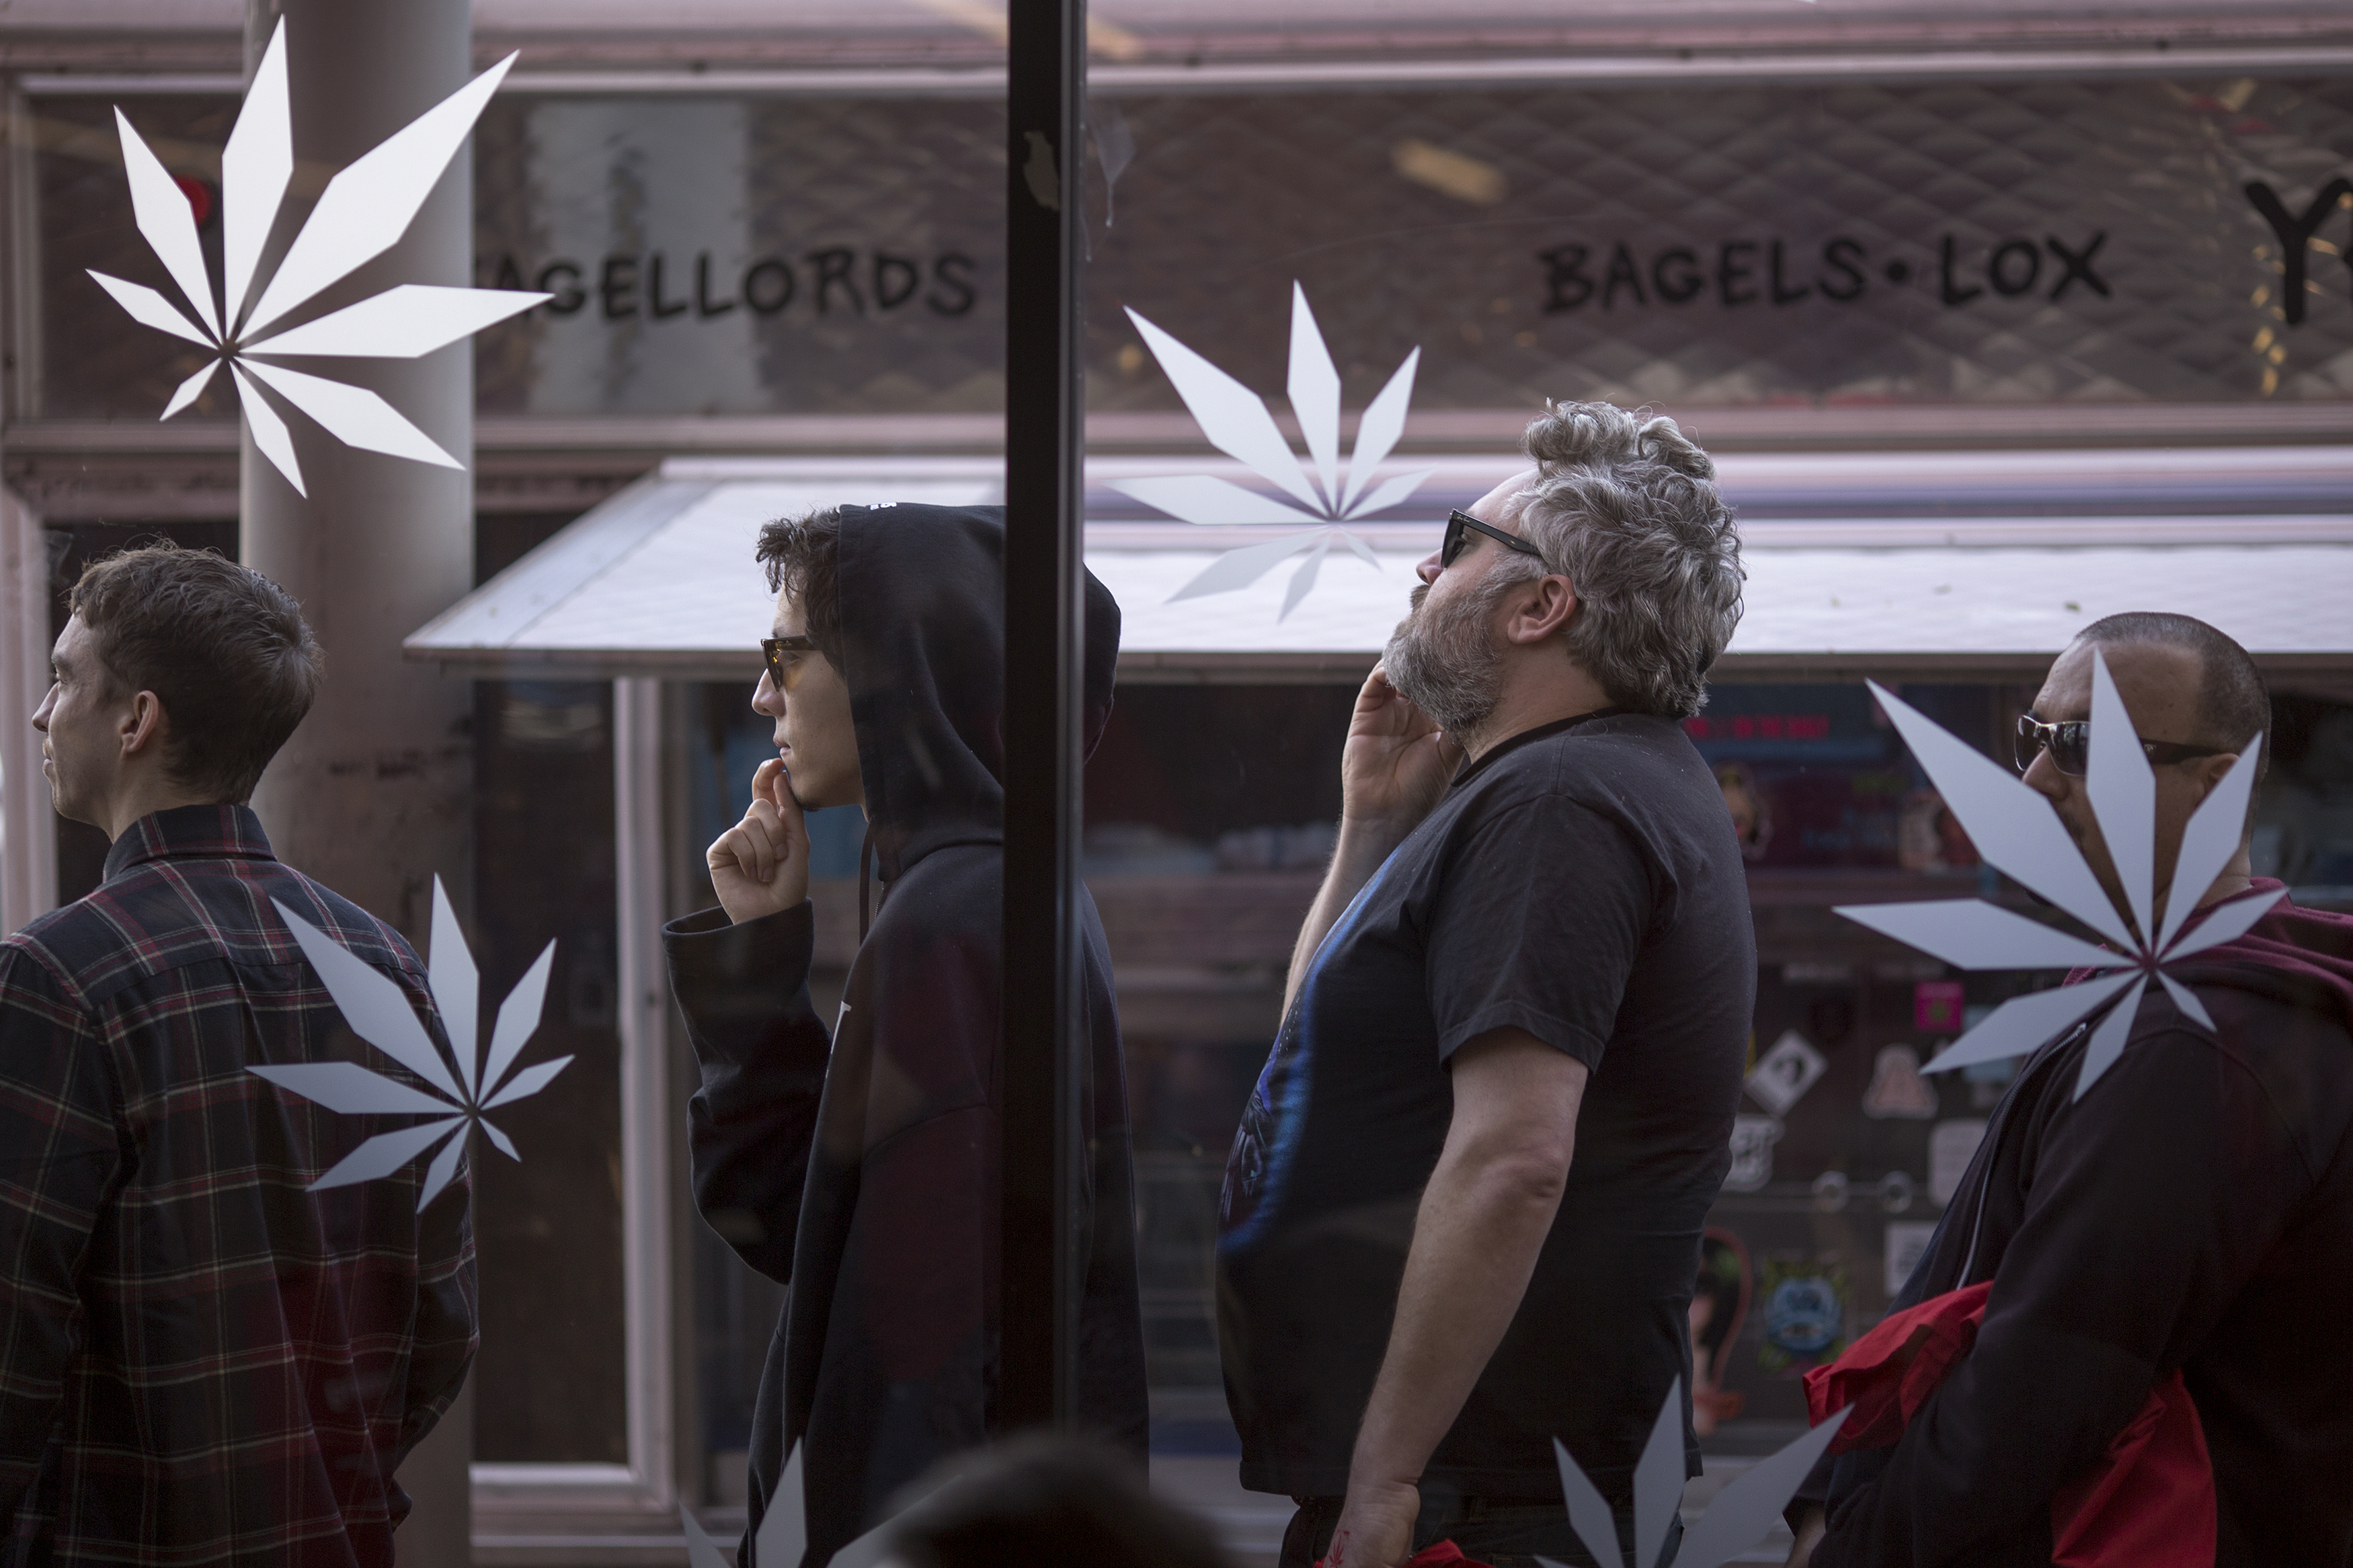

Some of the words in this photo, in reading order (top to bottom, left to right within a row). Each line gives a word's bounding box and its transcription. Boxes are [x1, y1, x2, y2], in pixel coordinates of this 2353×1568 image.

[475, 247, 978, 319] AGELLORDS
[1538, 238, 1866, 313] BAGELS
[1942, 231, 2110, 308] LOX
[2245, 178, 2353, 325] Y
